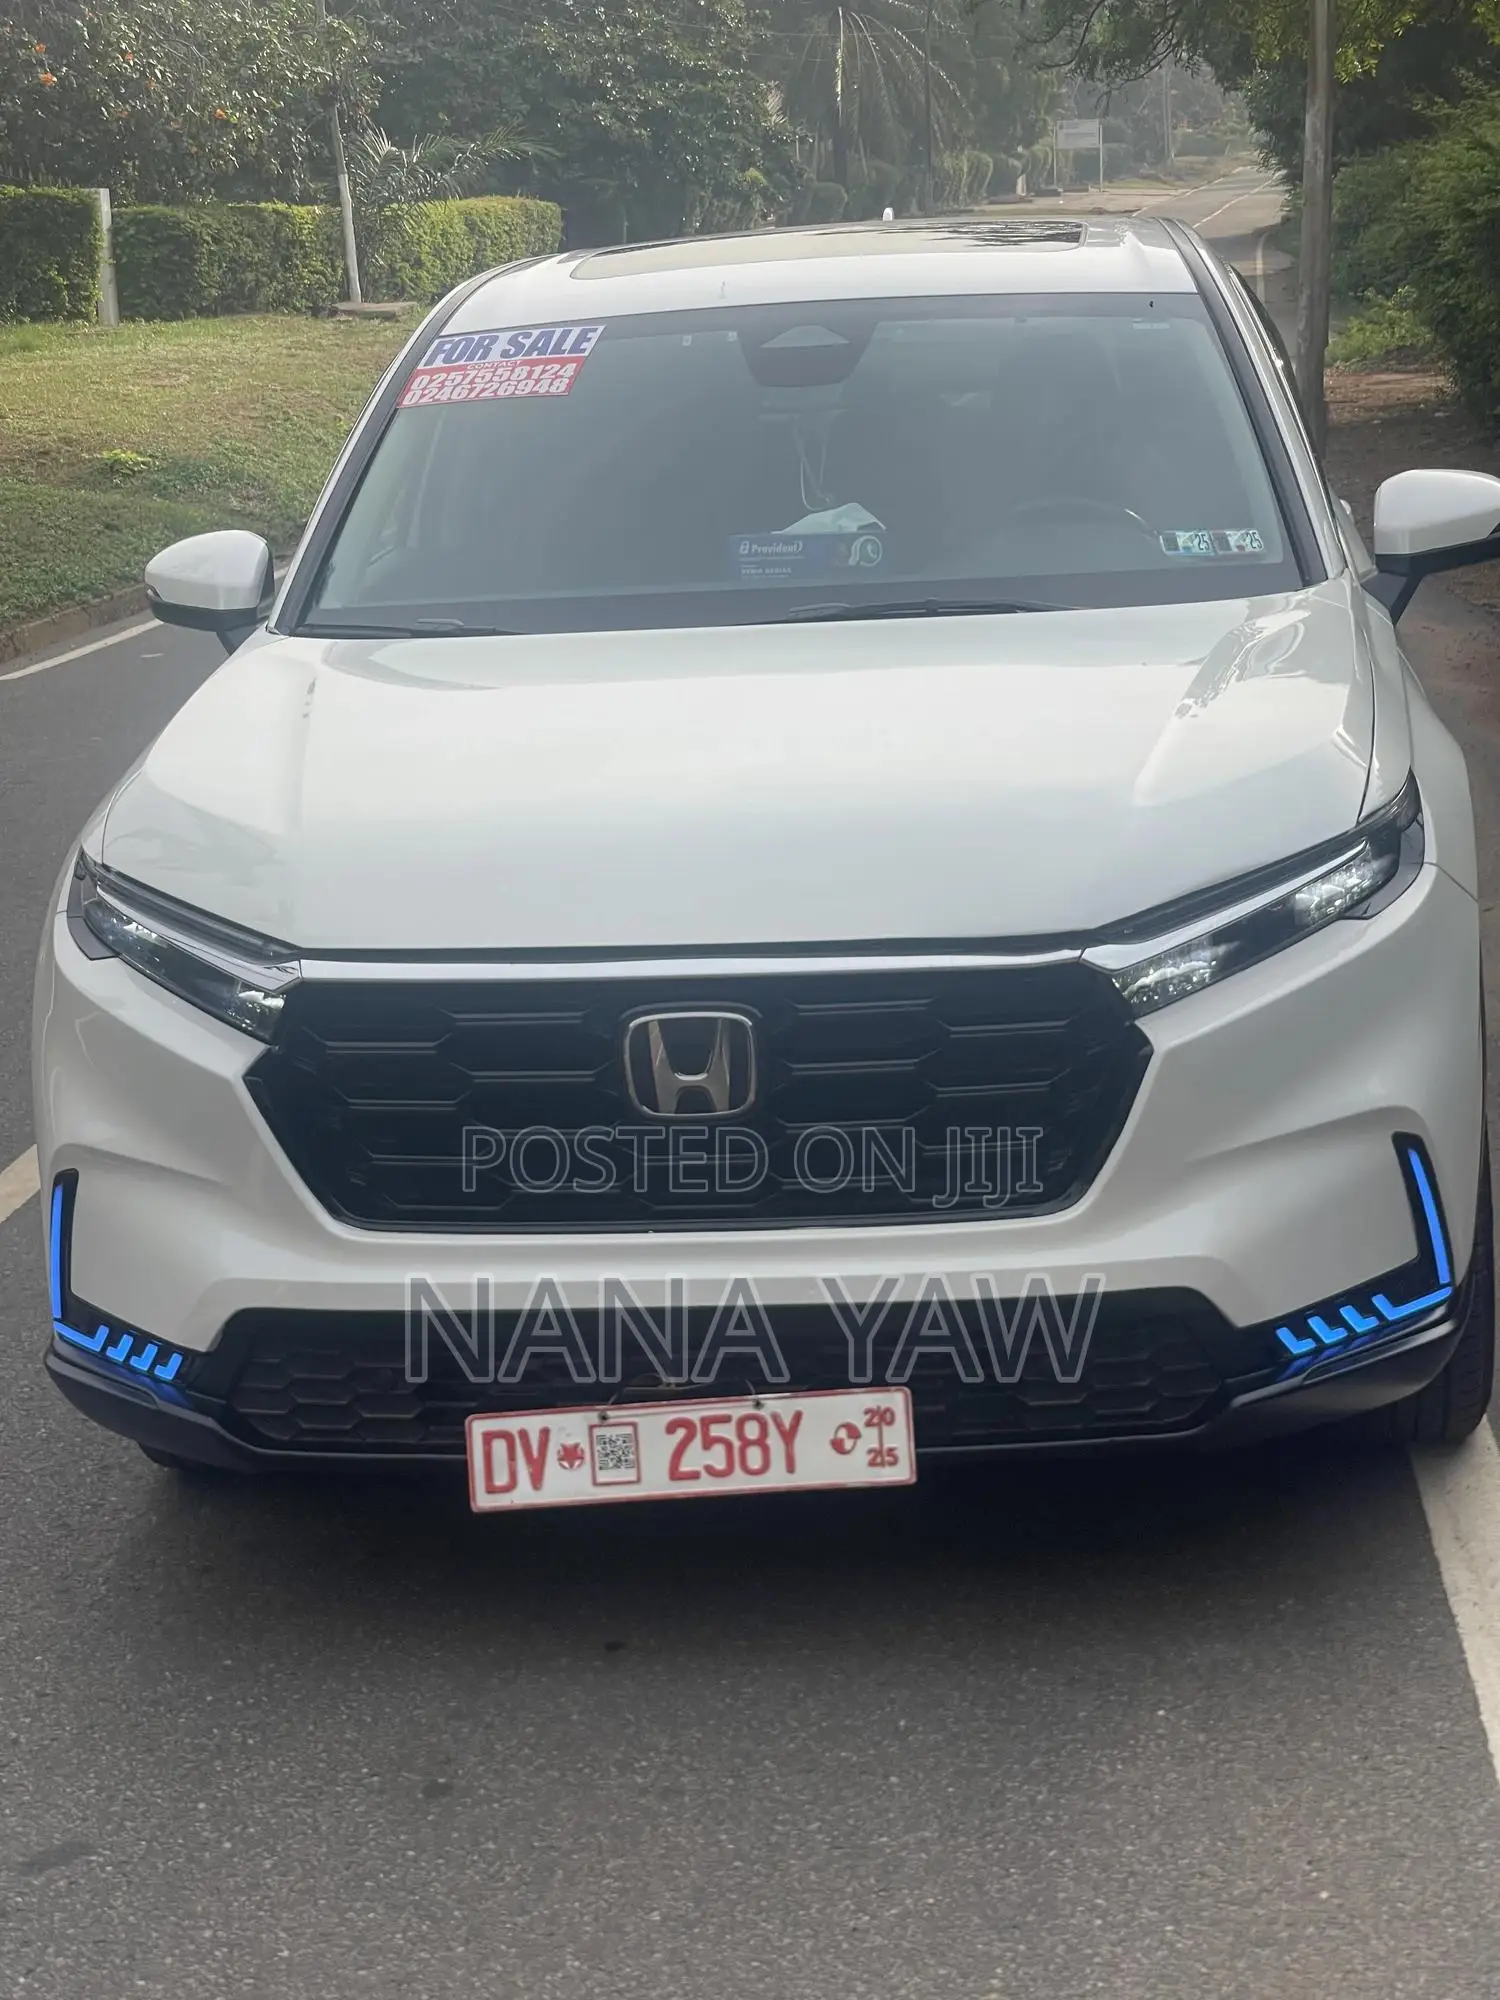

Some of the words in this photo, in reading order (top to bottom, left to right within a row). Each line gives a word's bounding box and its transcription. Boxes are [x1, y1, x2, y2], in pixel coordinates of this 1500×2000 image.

[423, 334, 500, 367] FOR
[500, 327, 599, 359] SALE
[466, 360, 522, 370] CONTACT
[412, 363, 578, 391] 0257558124
[402, 377, 570, 406] 0246726948
[1194, 533, 1210, 551] 25
[1246, 531, 1263, 549] 25
[863, 1406, 896, 1428] 20
[481, 1425, 551, 1495] DV
[664, 1409, 804, 1482] 258Y
[866, 1447, 900, 1468] 25
